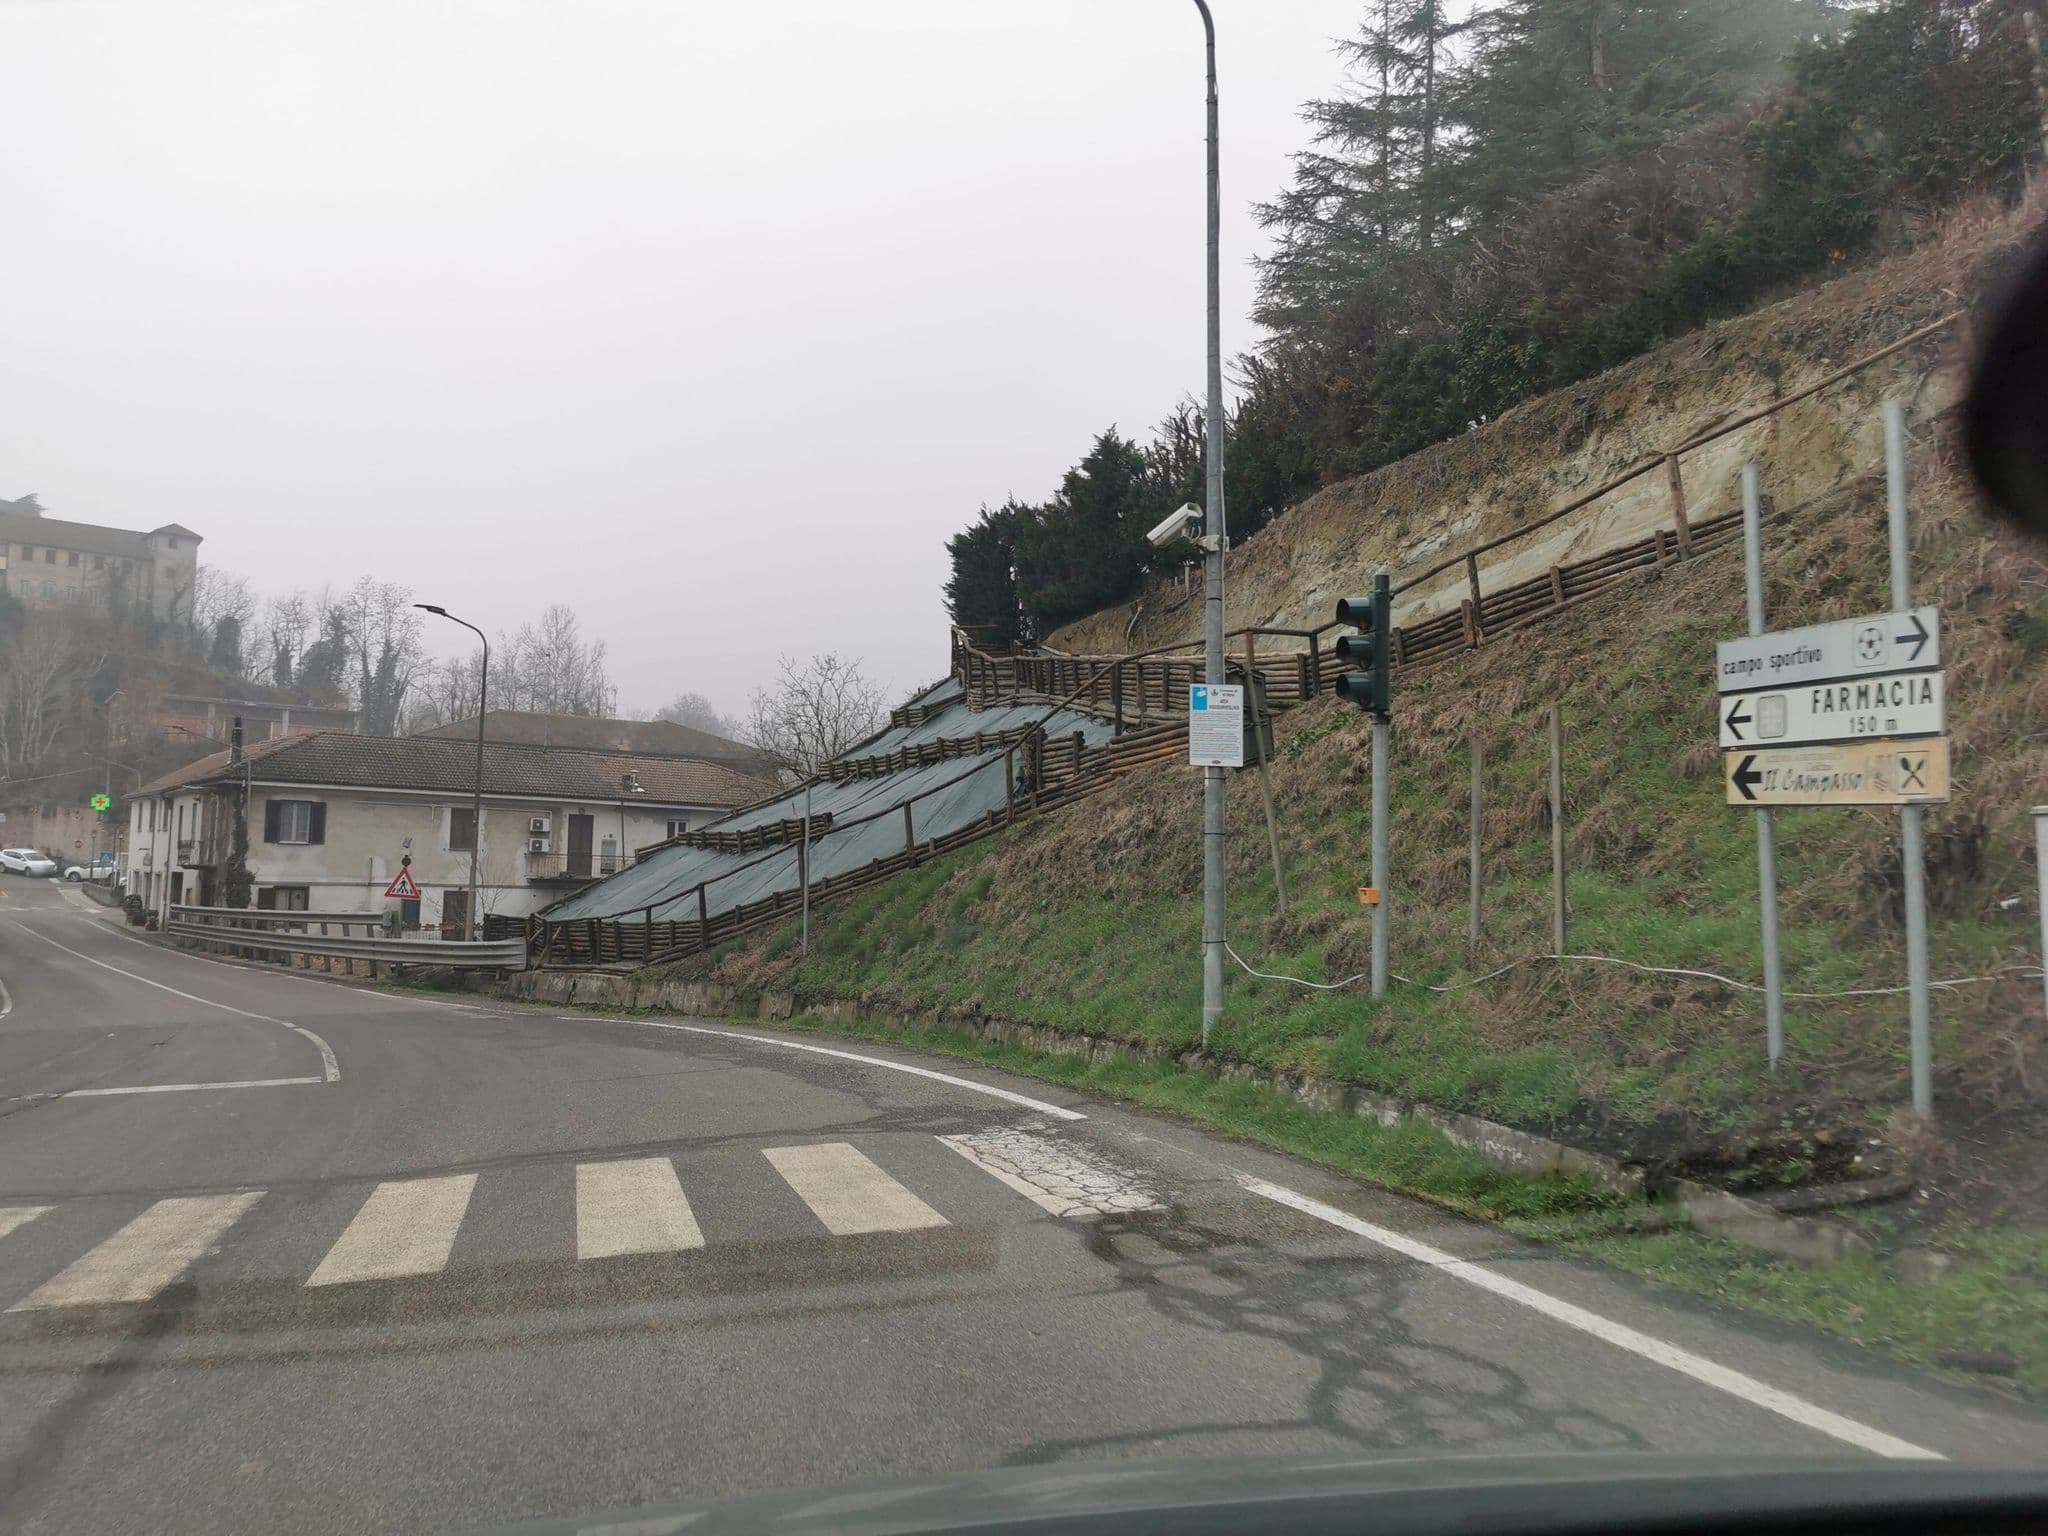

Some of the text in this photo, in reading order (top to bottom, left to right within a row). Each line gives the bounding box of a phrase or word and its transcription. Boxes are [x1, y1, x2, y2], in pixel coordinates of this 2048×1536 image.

[1723, 645, 1823, 676] campo sportivo
[1812, 677, 1934, 714] FARMACIA
[1850, 715, 1898, 734] 150 m
